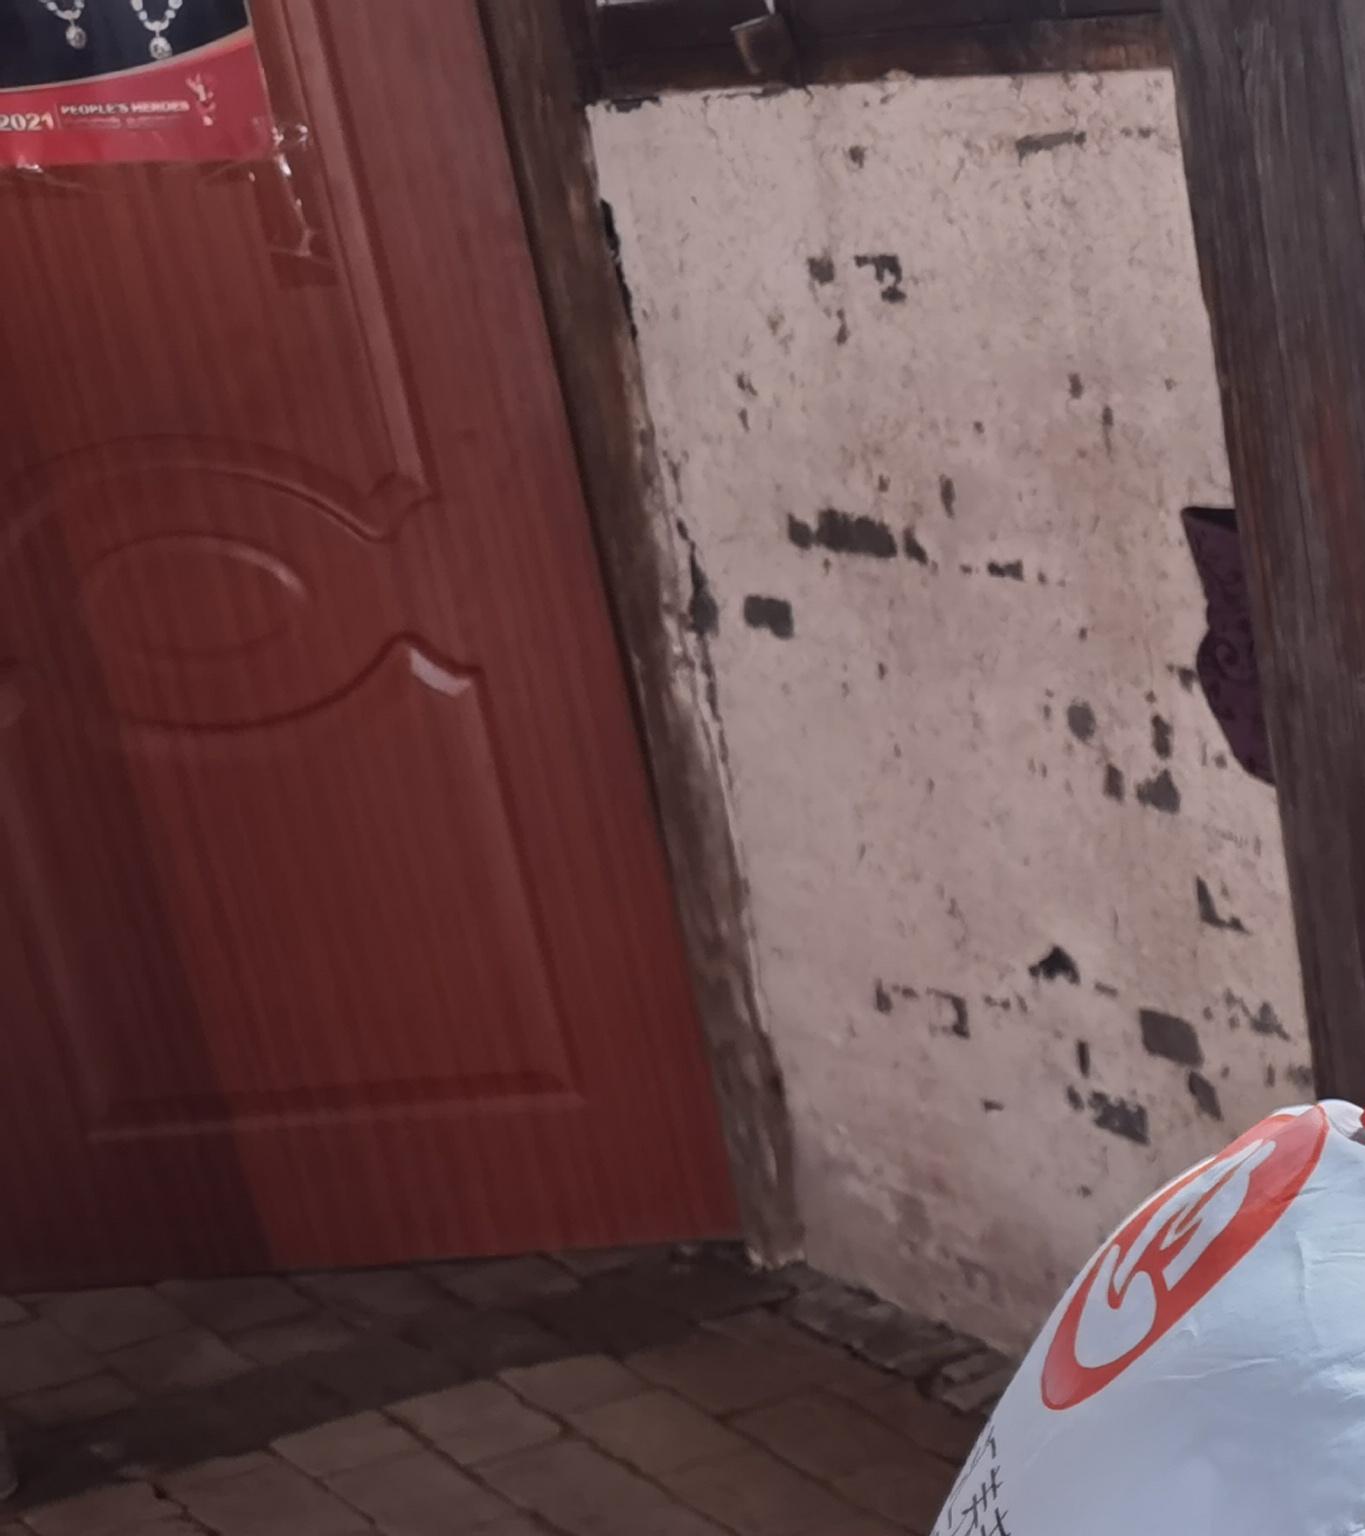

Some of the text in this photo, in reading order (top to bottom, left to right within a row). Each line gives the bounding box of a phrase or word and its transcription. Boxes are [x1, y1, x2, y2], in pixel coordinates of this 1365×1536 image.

[61, 100, 190, 115] PEOPLE'S HEROES
[0, 113, 54, 131] 2021
